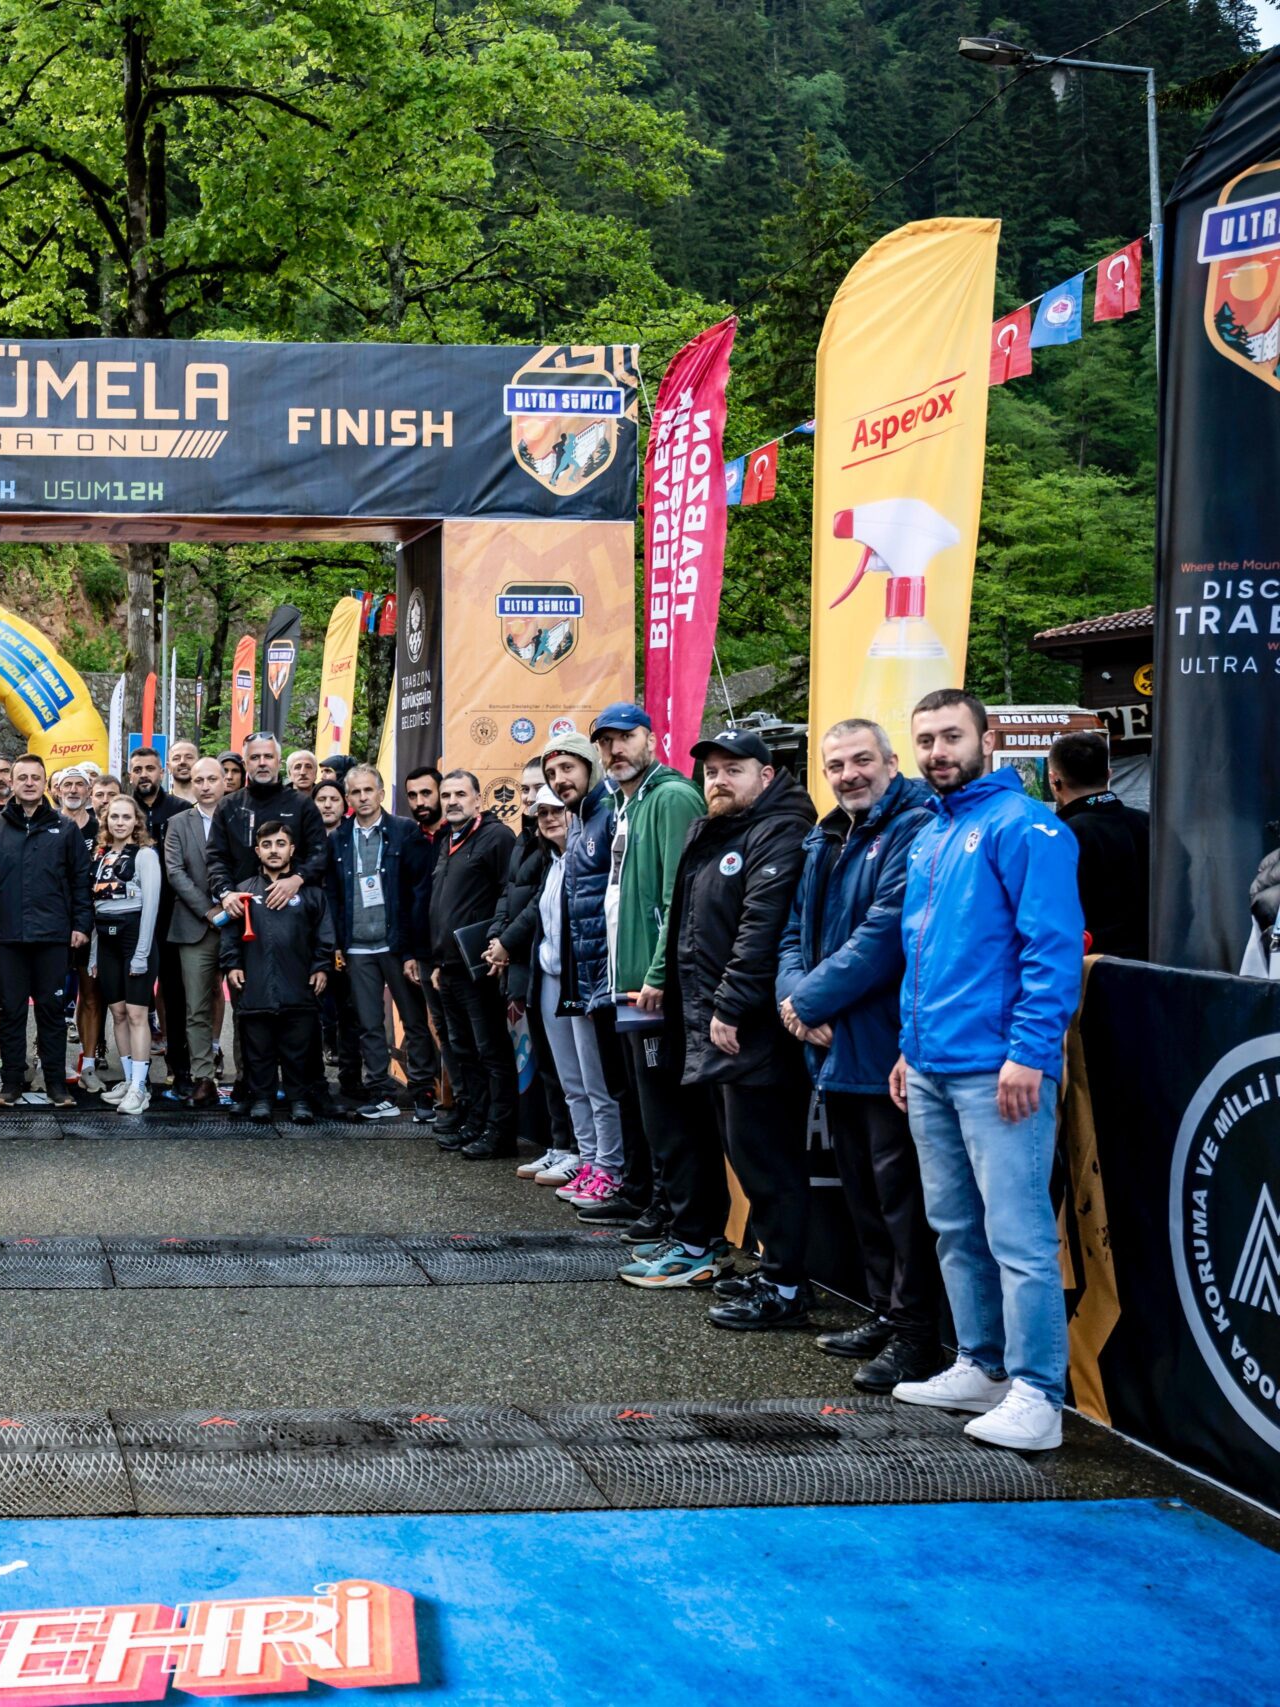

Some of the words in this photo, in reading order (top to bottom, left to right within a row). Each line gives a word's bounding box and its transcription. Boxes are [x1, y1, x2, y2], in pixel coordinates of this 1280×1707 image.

[1220, 207, 1280, 246] ULTR
[514, 391, 557, 410] ULTRA
[561, 392, 613, 411] SÜMELA
[288, 408, 454, 448] FINISH
[851, 388, 957, 451] Asperox
[44, 480, 163, 501] USUM12K
[1180, 562, 1215, 574] Where
[1218, 561, 1239, 571] the
[1203, 580, 1280, 600] DISC
[504, 600, 534, 612] ULTRA
[537, 599, 576, 612] SÜMELA
[1180, 656, 1258, 675] ULTRA
[401, 669, 431, 691] TRABZON
[998, 714, 1071, 725] DOLMUŞ
[50, 743, 94, 756] Asperox
[1213, 1072, 1271, 1139] MİLLİ
[1195, 1135, 1220, 1177] VE
[1192, 1188, 1230, 1334] KORUMA
[1230, 1334, 1280, 1410] OĞA
